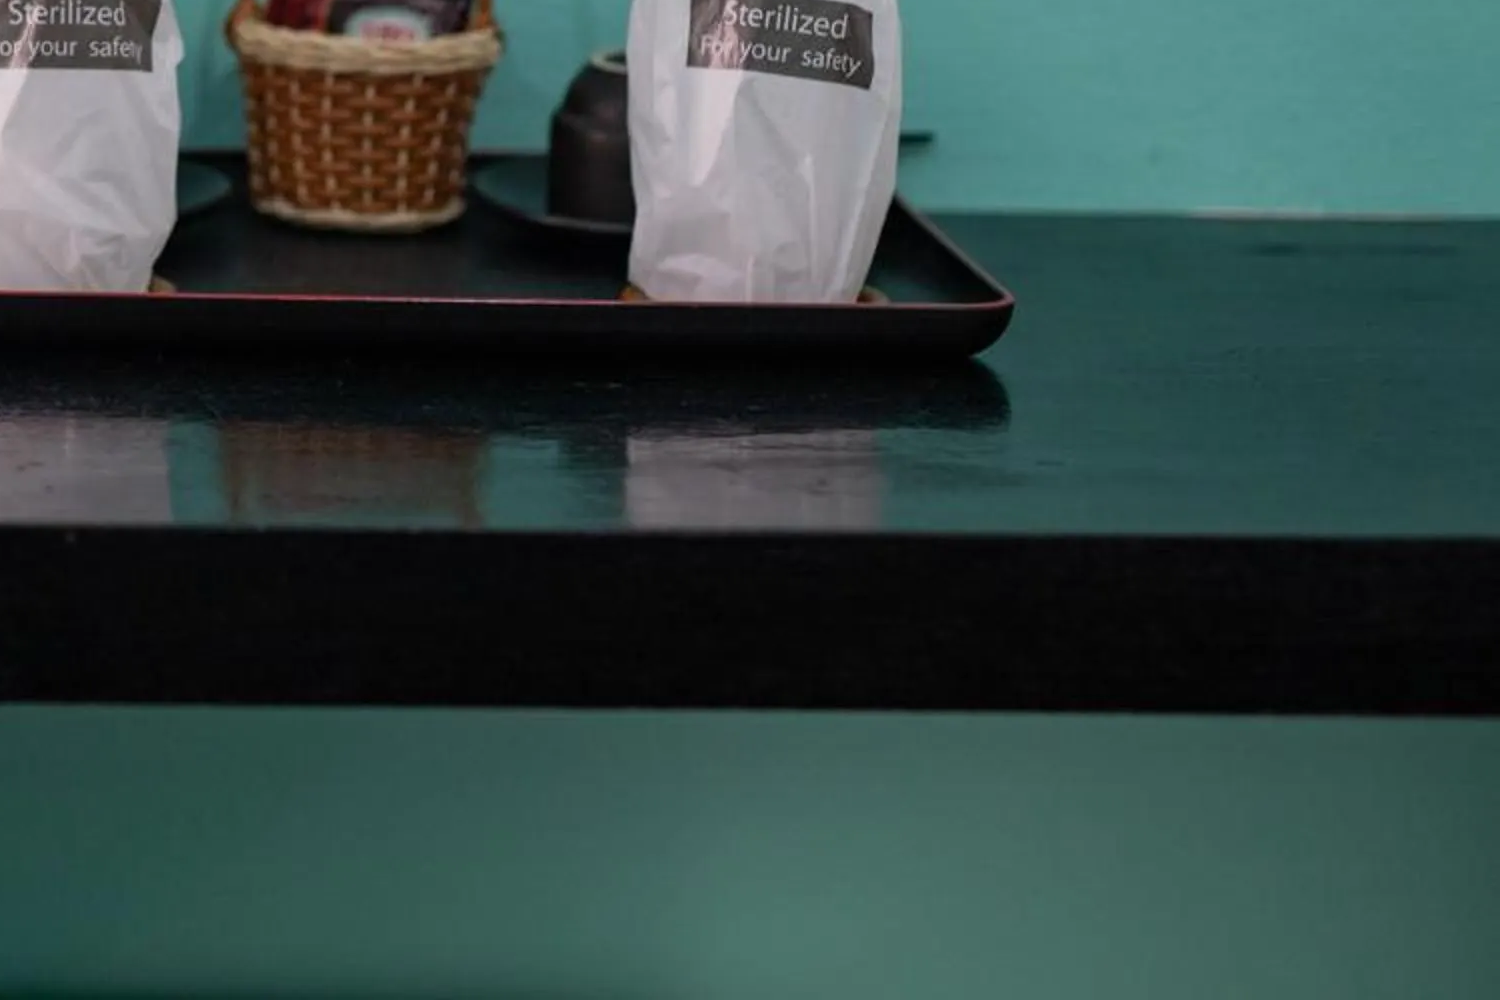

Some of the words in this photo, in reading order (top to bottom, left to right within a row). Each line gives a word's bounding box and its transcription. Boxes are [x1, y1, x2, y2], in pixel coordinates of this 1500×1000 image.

[723, 0, 849, 40] Sterilized
[28, 40, 77, 61] your
[740, 40, 792, 63] your
[801, 48, 861, 78] safety
